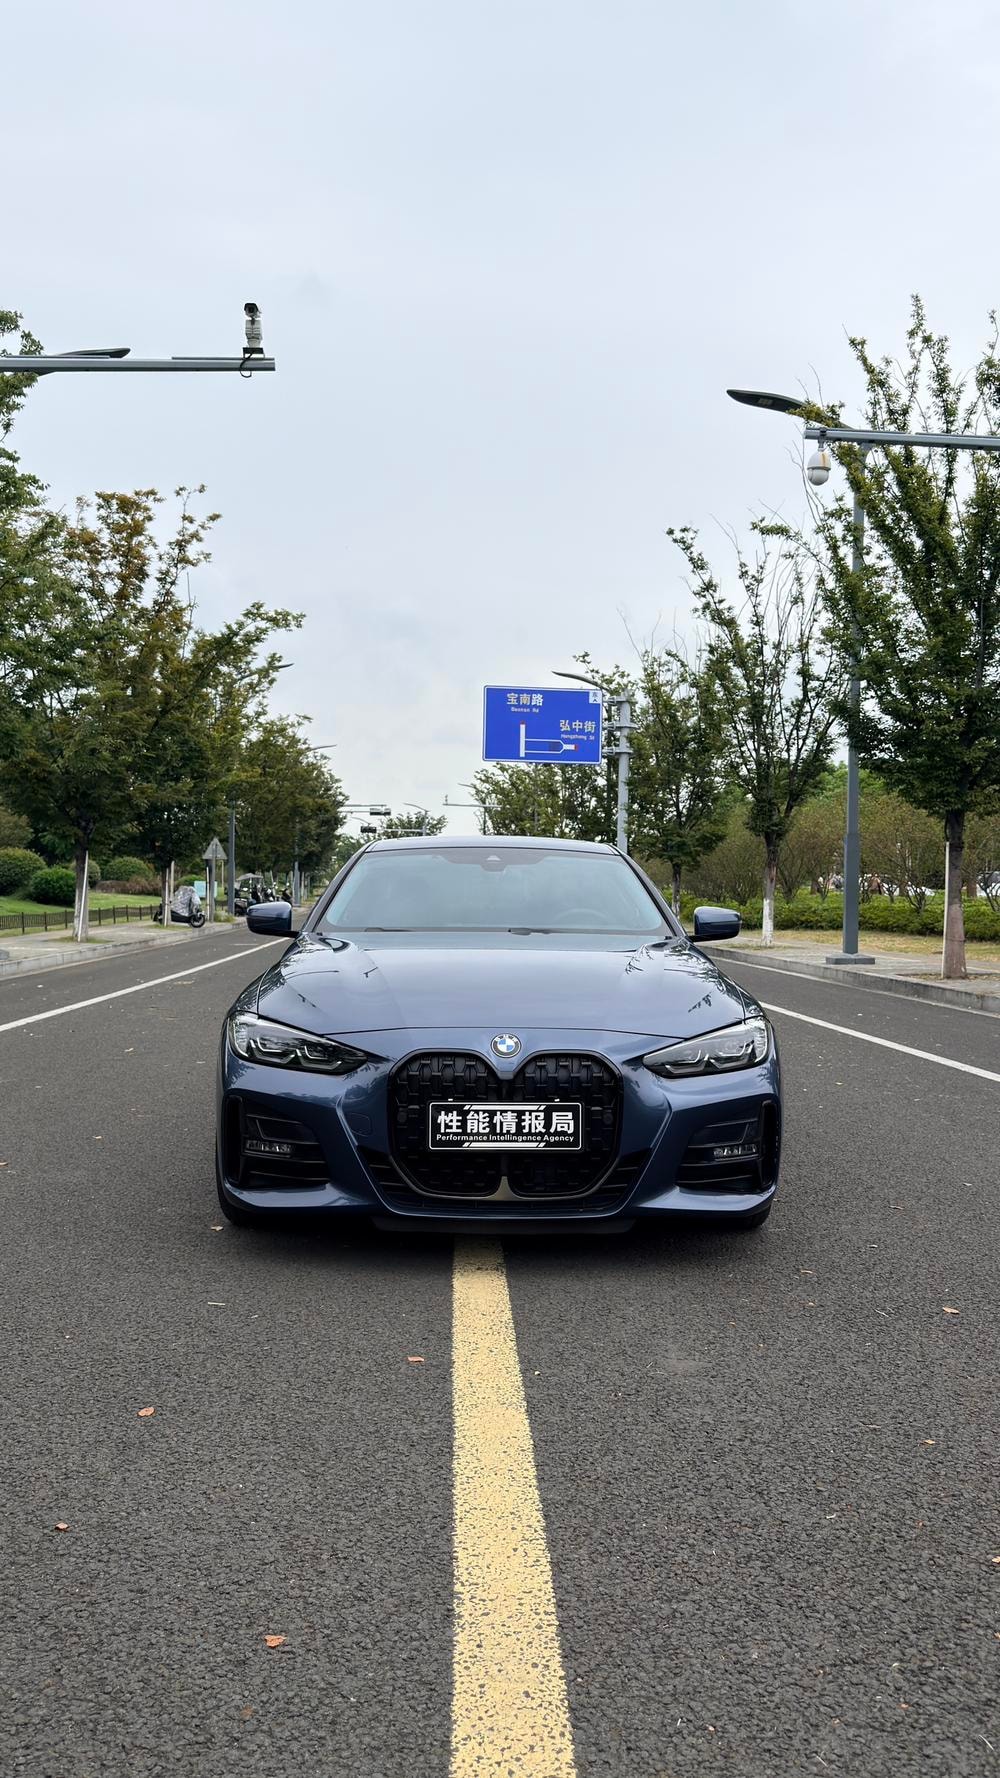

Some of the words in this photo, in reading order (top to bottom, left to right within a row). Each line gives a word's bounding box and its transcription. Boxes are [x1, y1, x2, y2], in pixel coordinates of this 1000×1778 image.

[506, 692, 544, 706] 宝南路
[560, 720, 596, 733] 弘中街
[437, 1110, 575, 1134] 性能情报局
[489, 1134, 542, 1142] Intellingence
[543, 1134, 574, 1142] Agency
